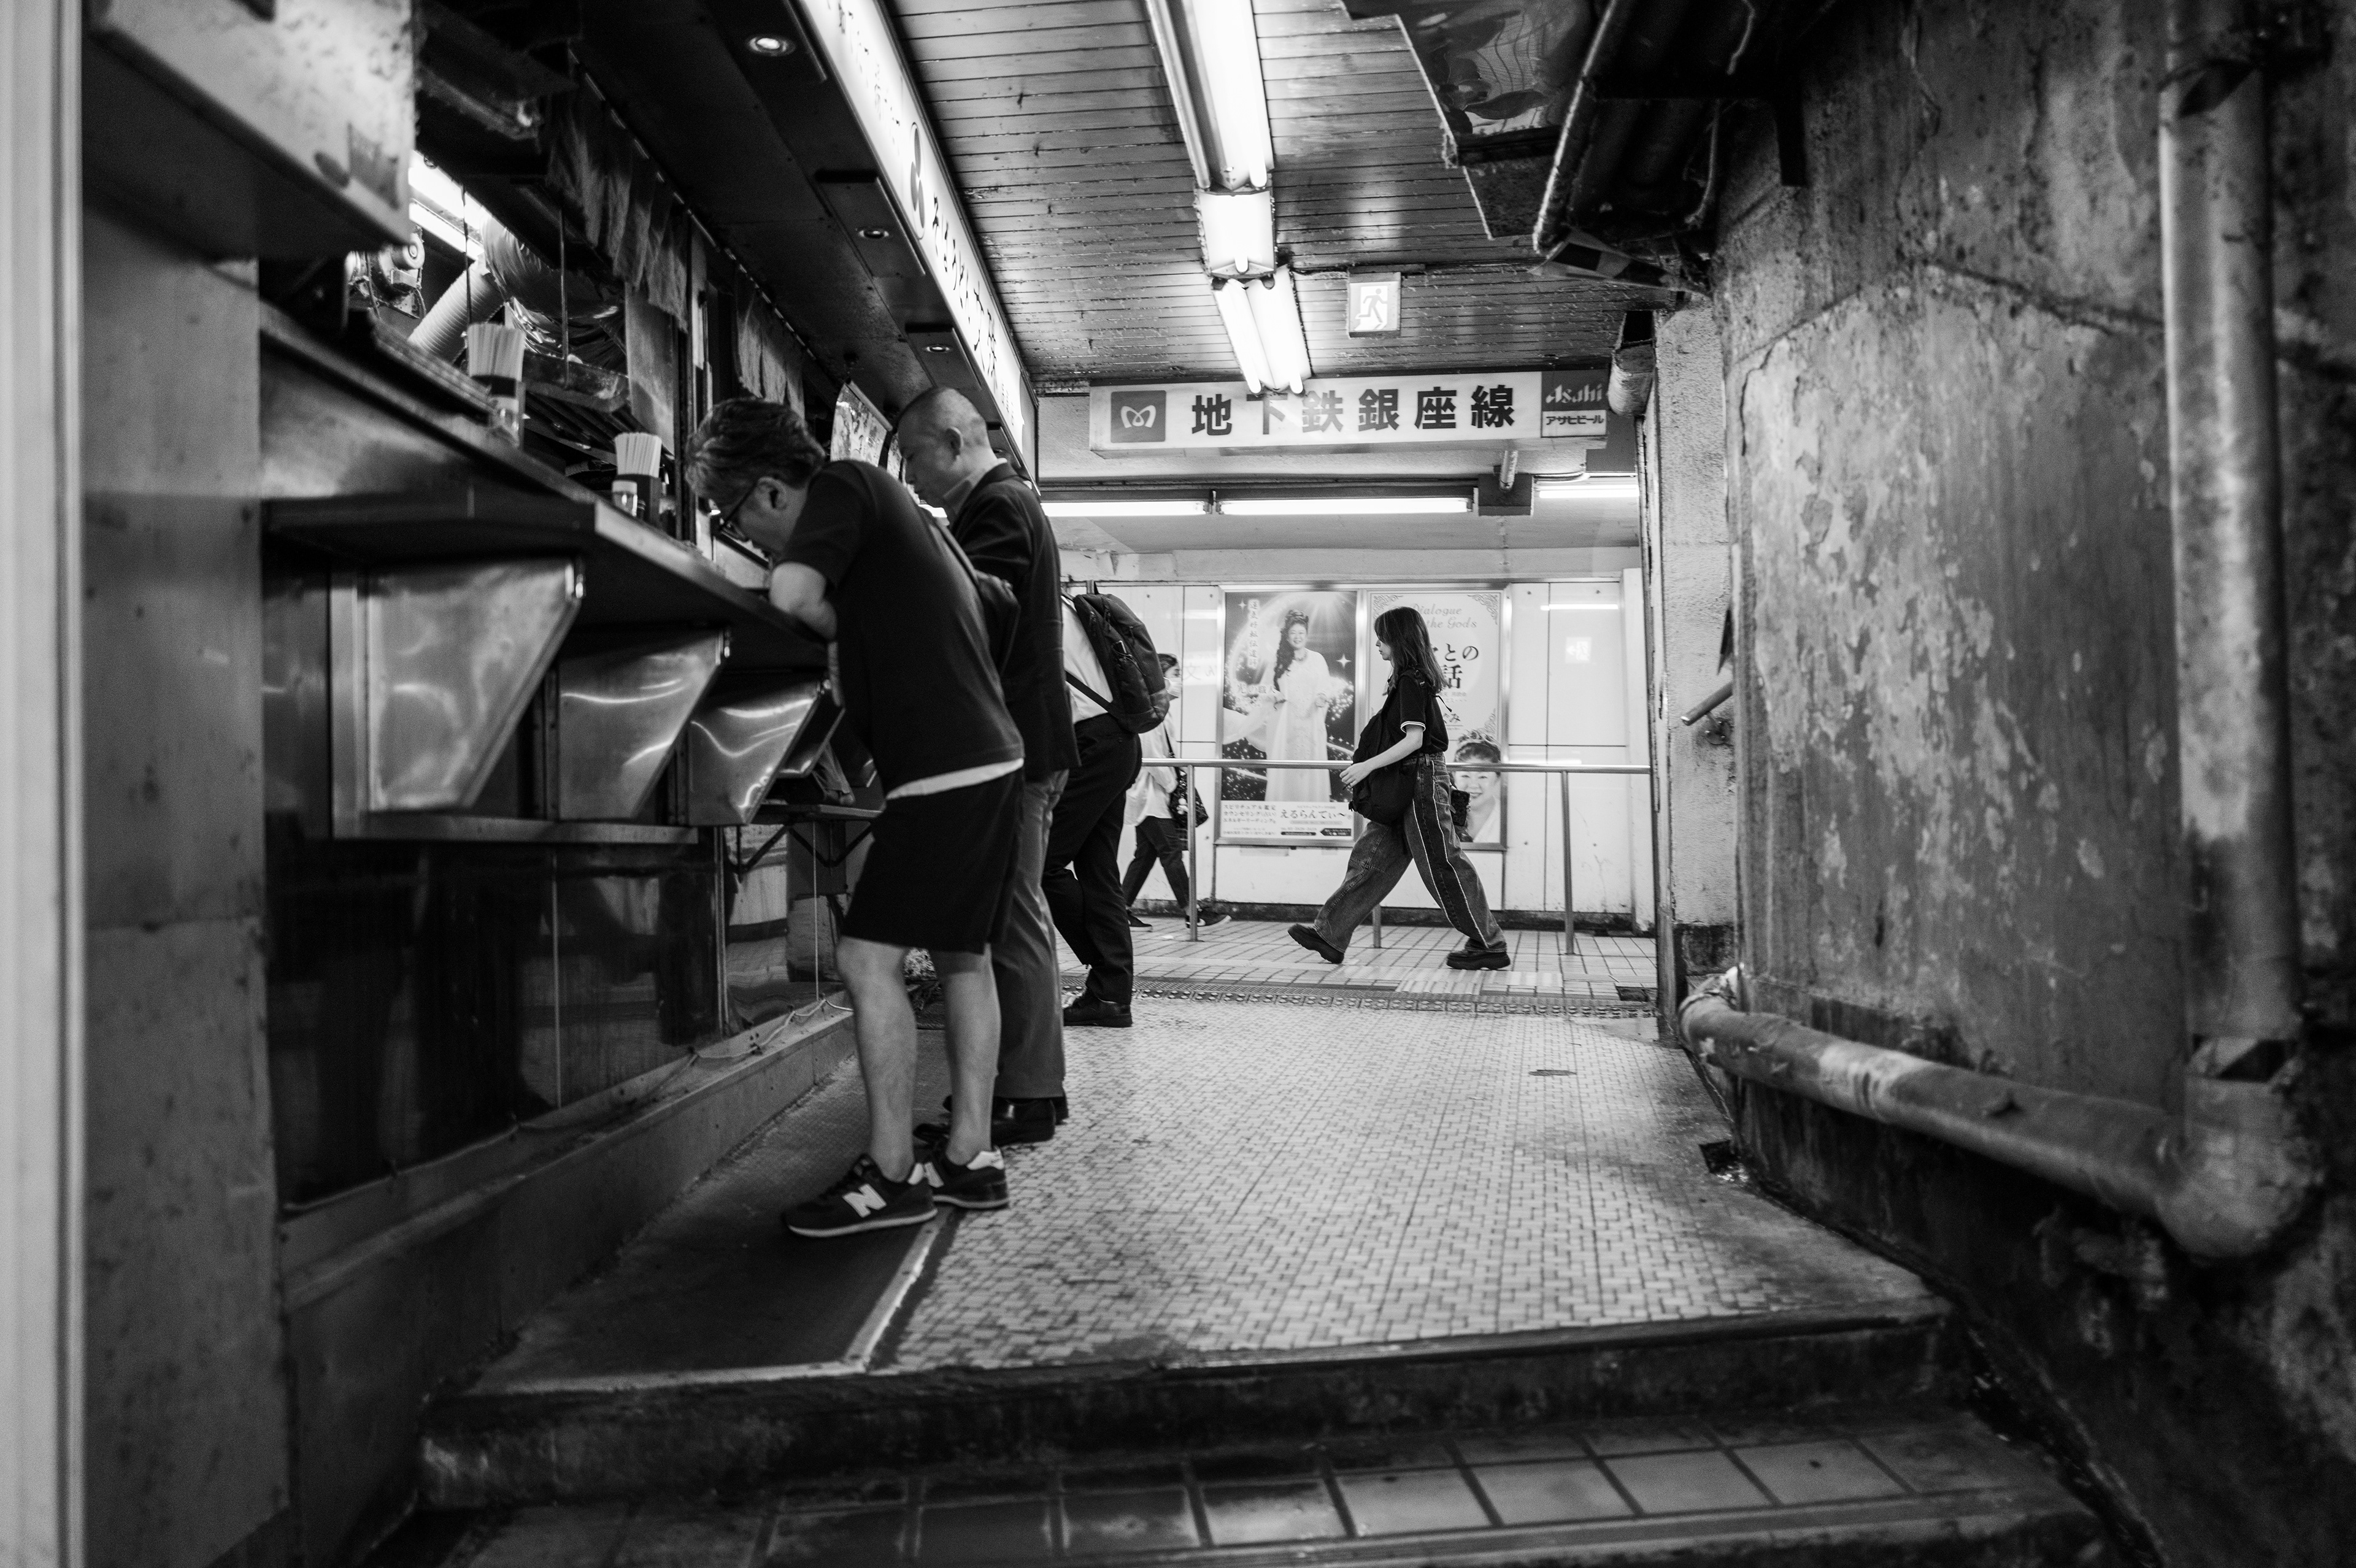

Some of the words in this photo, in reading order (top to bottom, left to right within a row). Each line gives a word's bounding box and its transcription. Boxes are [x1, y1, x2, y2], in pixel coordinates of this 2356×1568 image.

[1545, 383, 1603, 404] Asahi
[1191, 385, 1515, 436] 地下鉄銀座線
[1546, 415, 1604, 425] アサヒビール
[1447, 616, 1477, 629] Gods
[1432, 643, 1479, 662] との
